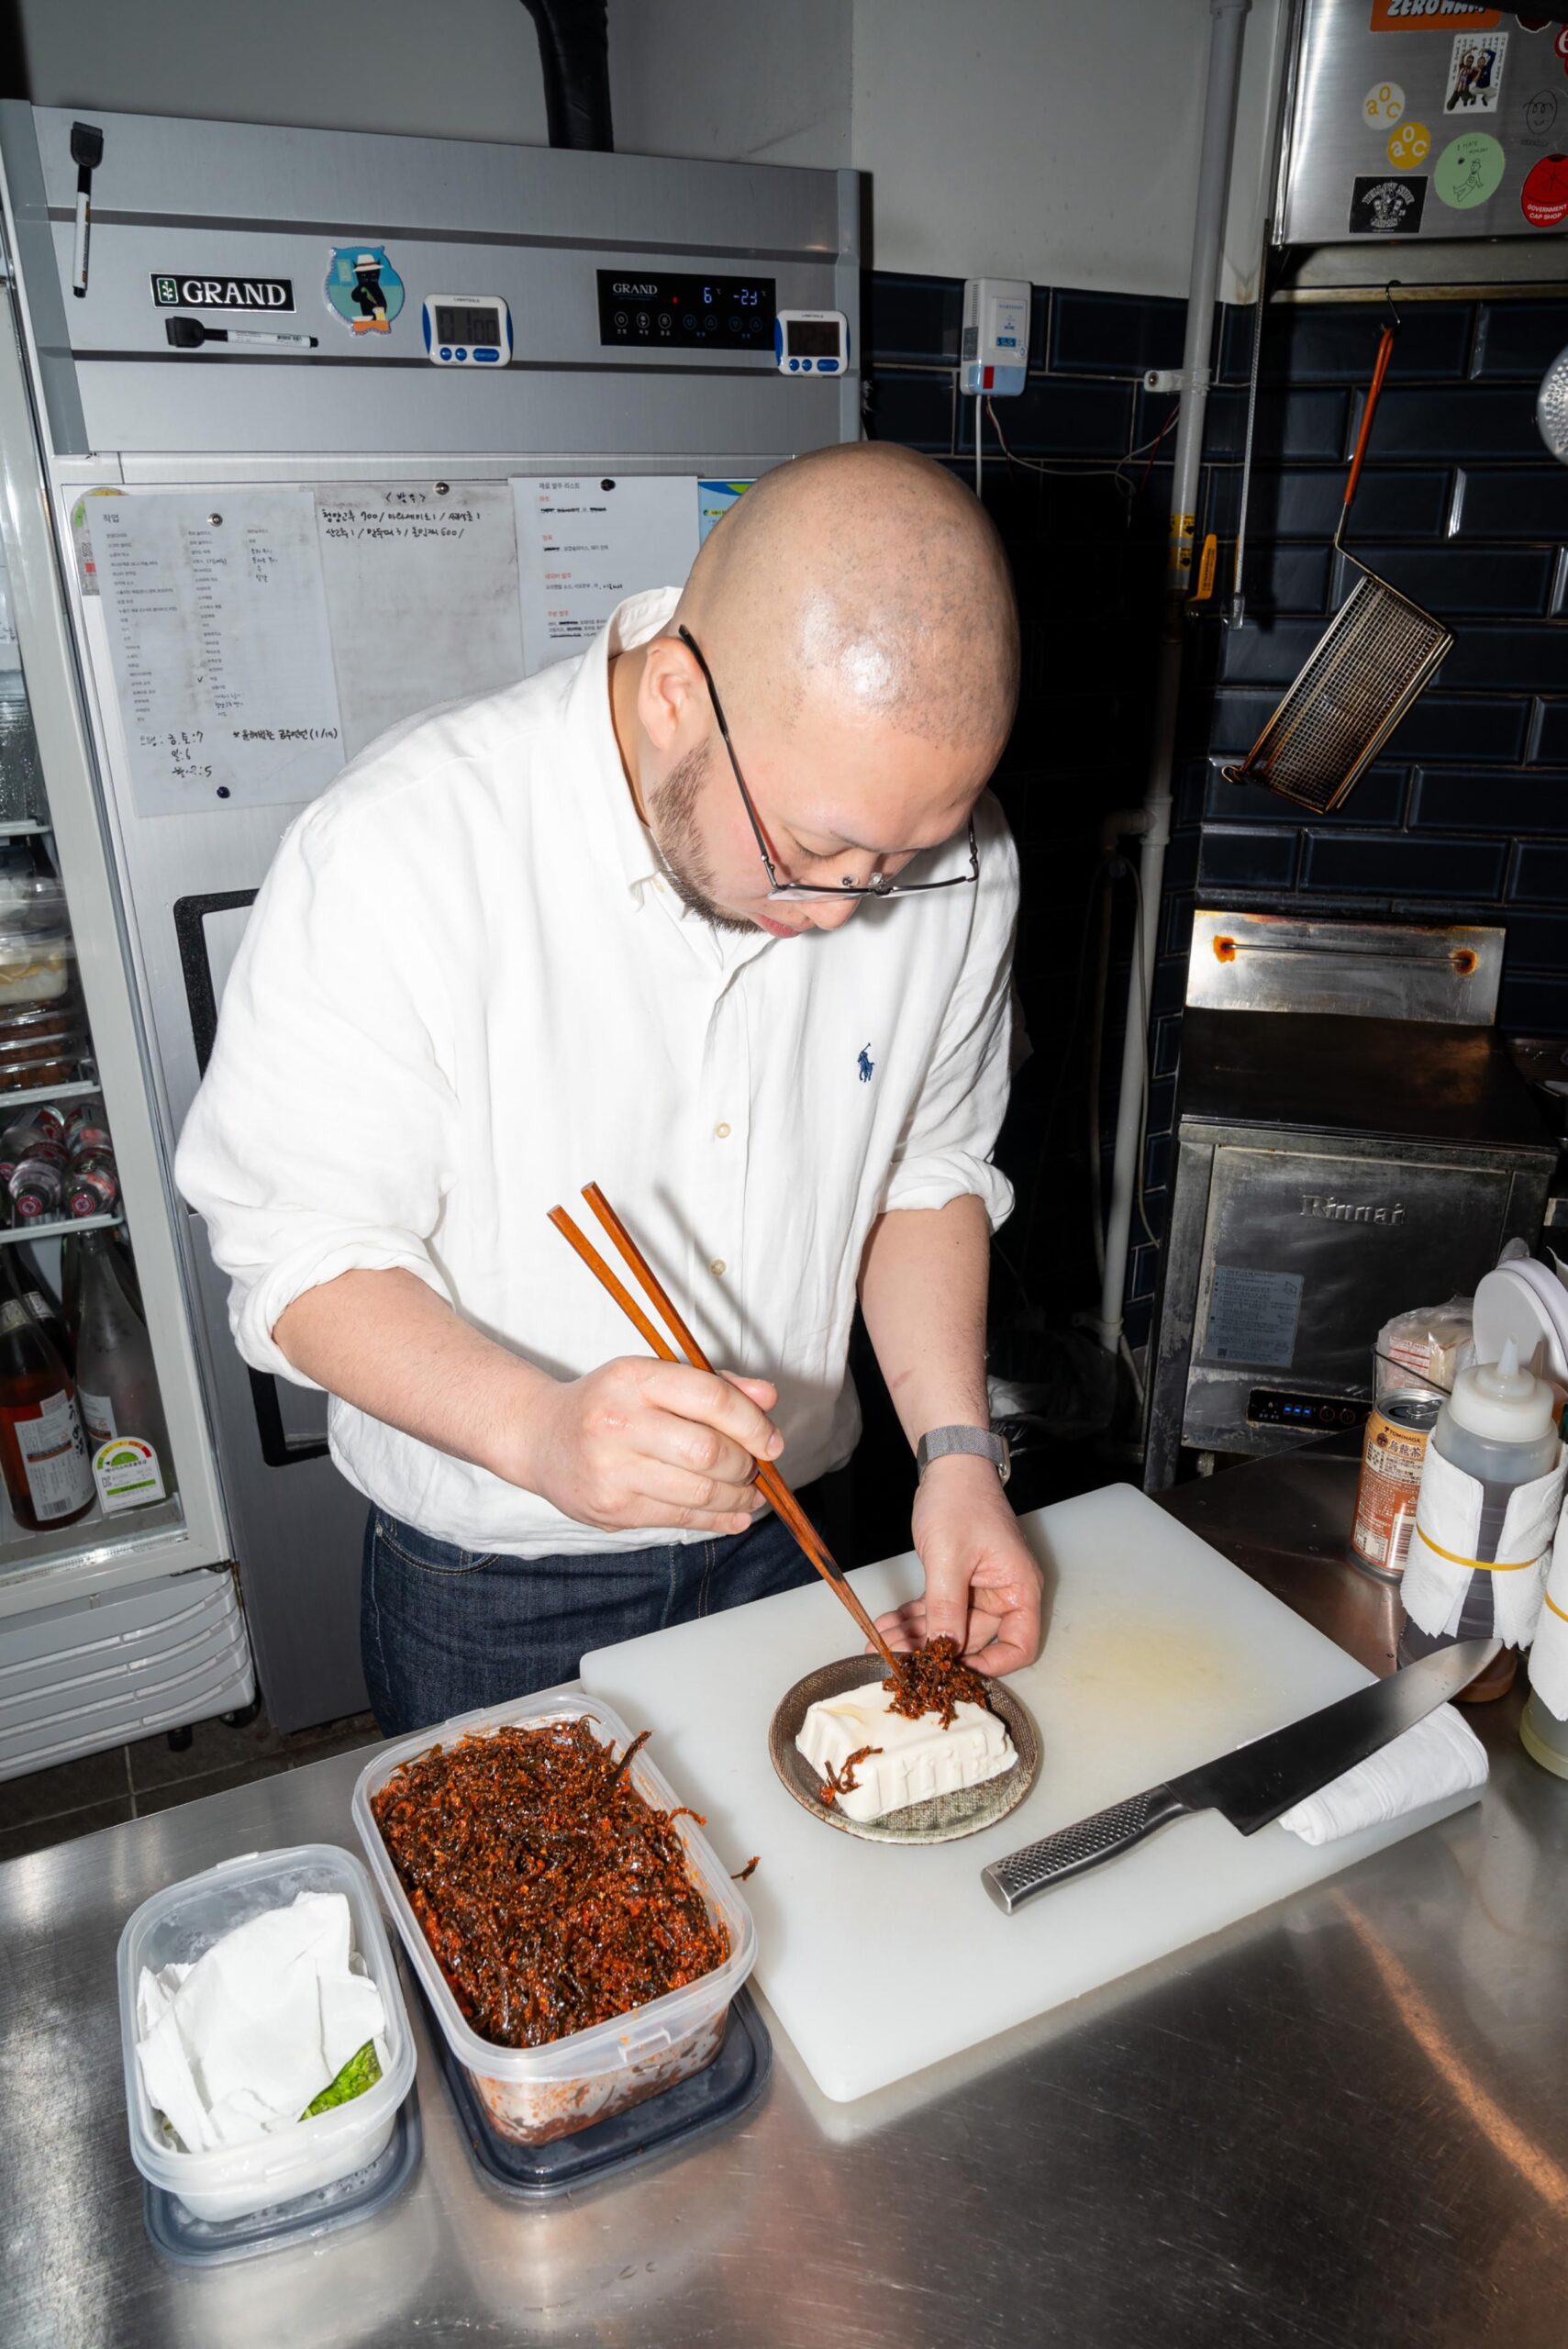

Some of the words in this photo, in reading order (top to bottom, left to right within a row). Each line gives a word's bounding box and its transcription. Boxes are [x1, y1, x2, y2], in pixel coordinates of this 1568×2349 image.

[1527, 203, 1567, 213] GOVERNMENT
[1543, 212, 1562, 220] SHOP
[183, 281, 287, 306] GRAND
[612, 283, 658, 295] GRAND
[703, 286, 713, 304] 6
[102, 514, 120, 524] 작업
[1299, 1194, 1407, 1226] Rinnai
[1388, 1430, 1421, 1443] TOMINAGA
